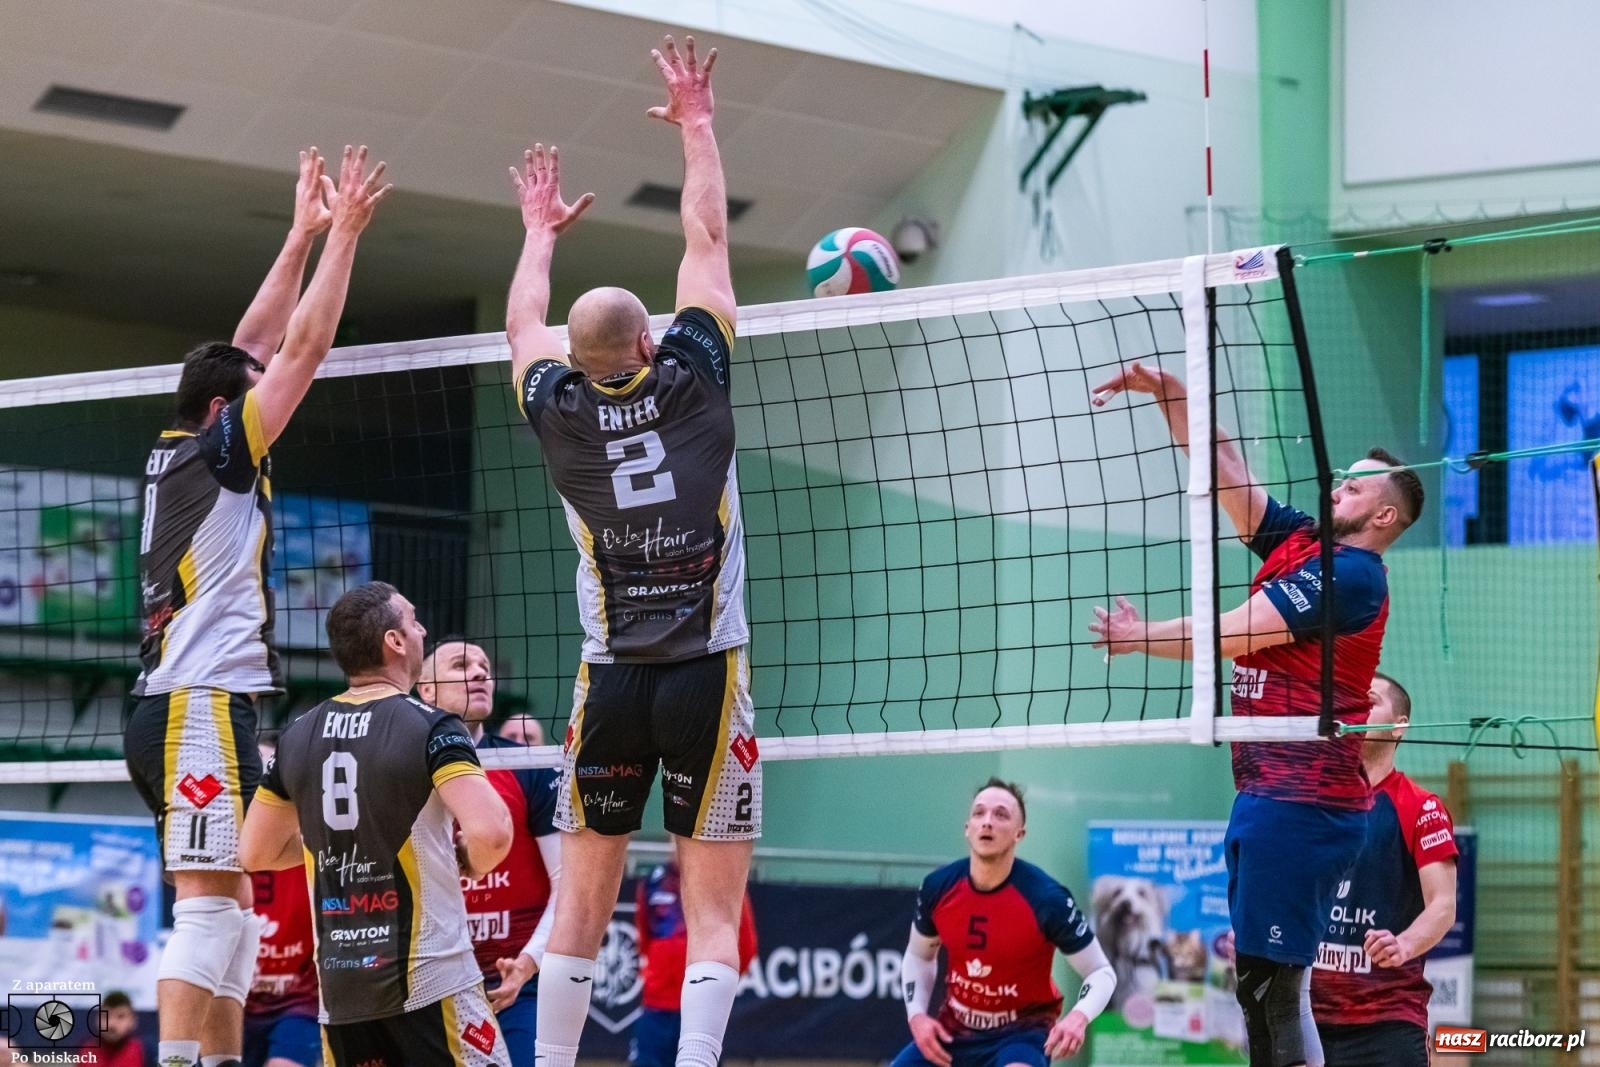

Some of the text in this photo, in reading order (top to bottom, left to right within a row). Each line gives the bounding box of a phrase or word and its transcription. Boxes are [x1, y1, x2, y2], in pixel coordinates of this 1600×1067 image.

[597, 395, 660, 431] ENTER
[605, 430, 677, 510] 2
[638, 516, 697, 563] Hair
[737, 738, 752, 762] Enter
[184, 778, 208, 800] Enter
[322, 751, 360, 831] 8
[735, 782, 753, 821] 2
[189, 815, 207, 850] 11
[336, 843, 376, 887] Hair
[460, 871, 510, 891] OLIK
[330, 925, 390, 941] GRAVTON
[1330, 905, 1377, 926] OLIK
[966, 916, 988, 951] 5
[737, 932, 904, 999] ACIBÓR
[469, 1027, 490, 1044] Enter
